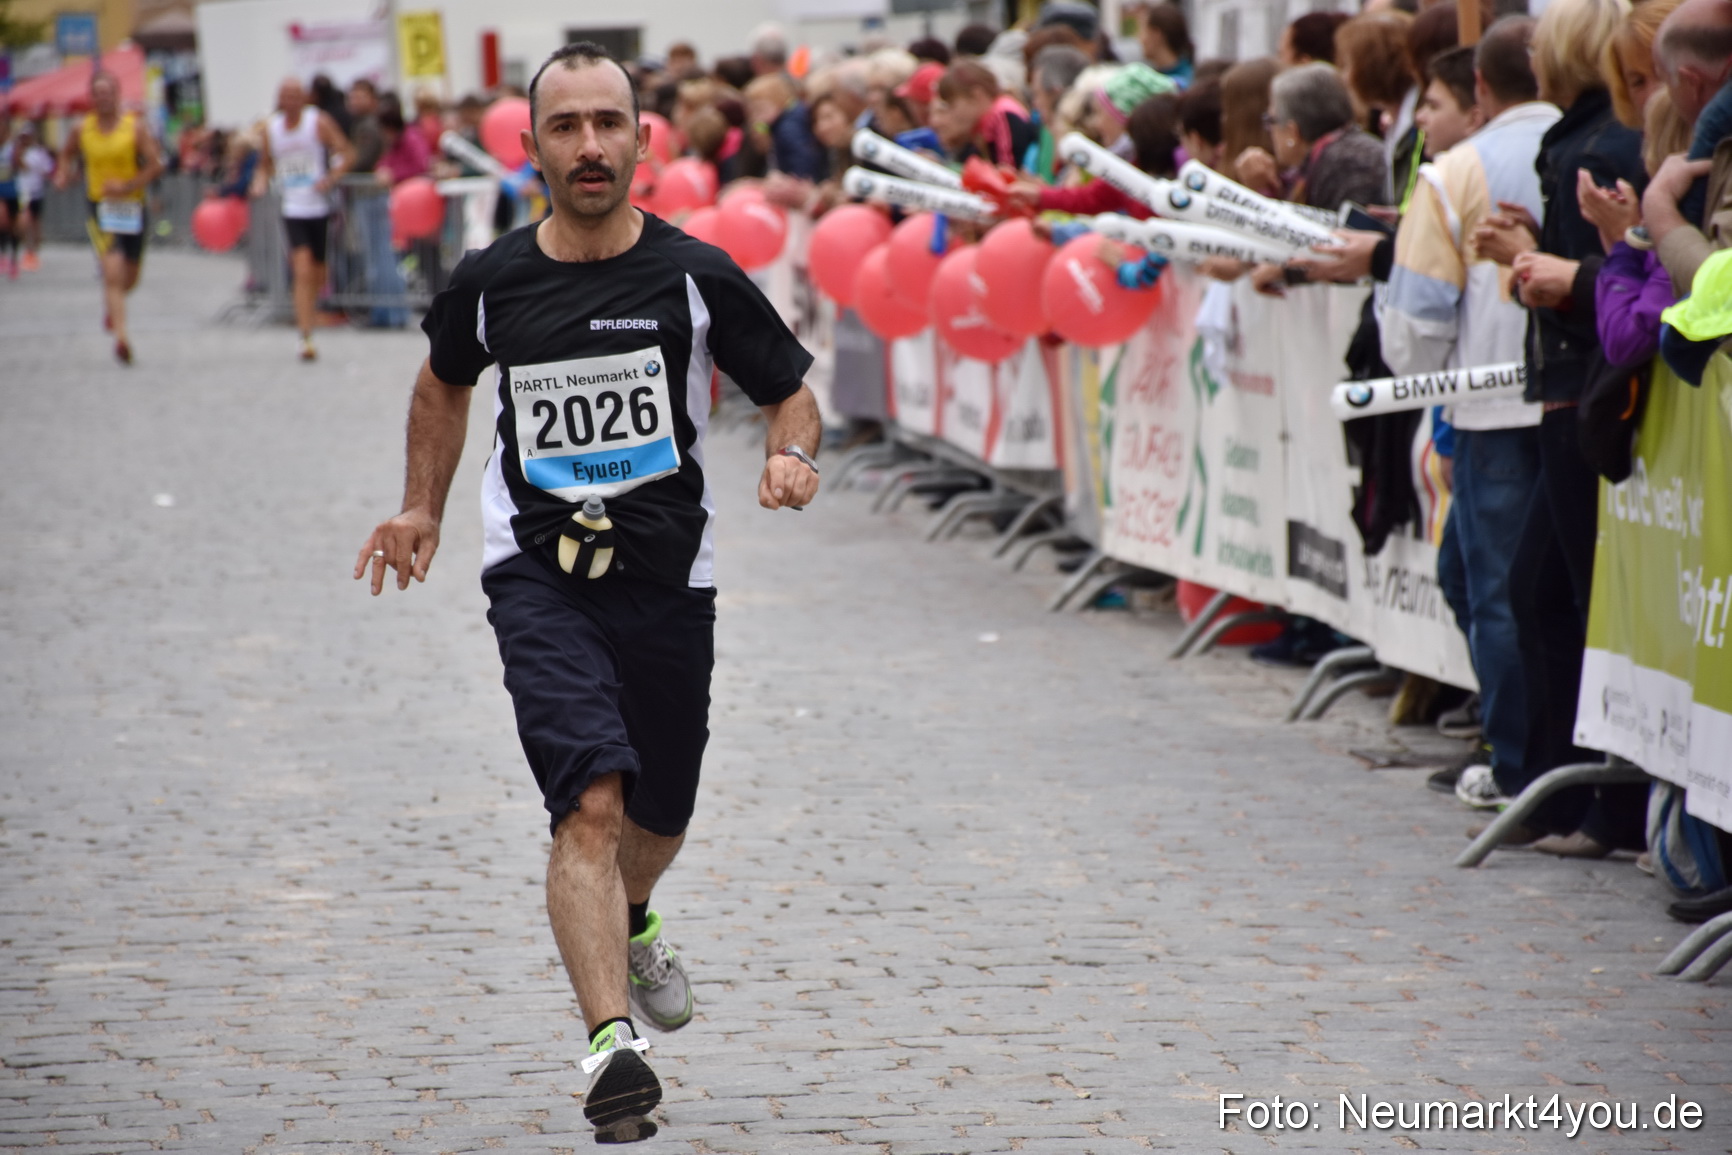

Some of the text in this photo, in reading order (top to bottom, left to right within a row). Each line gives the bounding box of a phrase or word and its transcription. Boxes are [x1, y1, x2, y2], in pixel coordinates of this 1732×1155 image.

[600, 319, 659, 330] PFLEIDERER
[514, 368, 640, 394] PARTL Neumarkt
[1393, 371, 1457, 401] BMW
[532, 386, 659, 450] 2026
[572, 459, 632, 484] Eyuep
